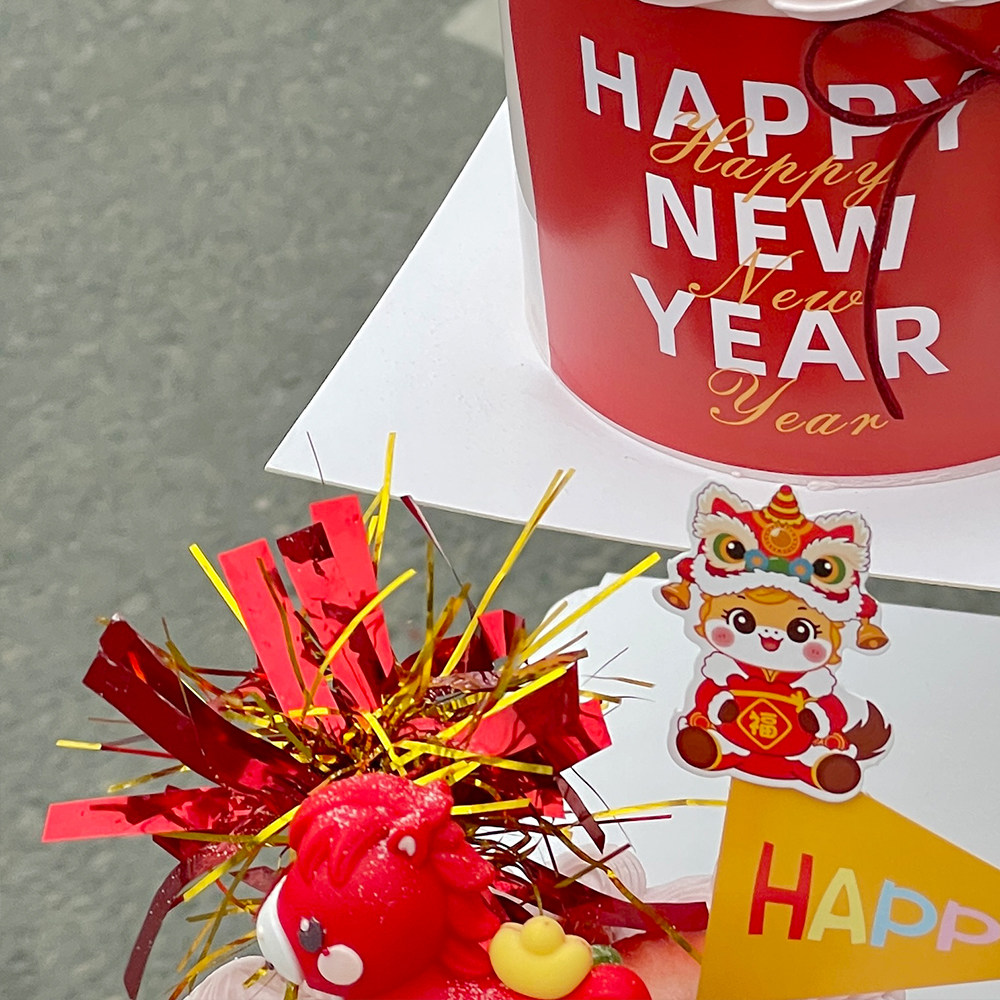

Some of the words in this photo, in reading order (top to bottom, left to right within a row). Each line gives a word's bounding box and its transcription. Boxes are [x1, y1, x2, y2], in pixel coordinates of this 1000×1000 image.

[579, 35, 983, 161] HAPPY
[649, 111, 898, 210] Happy
[645, 171, 917, 273] NEW
[630, 272, 950, 382] YEAR
[688, 246, 865, 314] New
[707, 367, 890, 436] Year
[748, 709, 779, 740] 福
